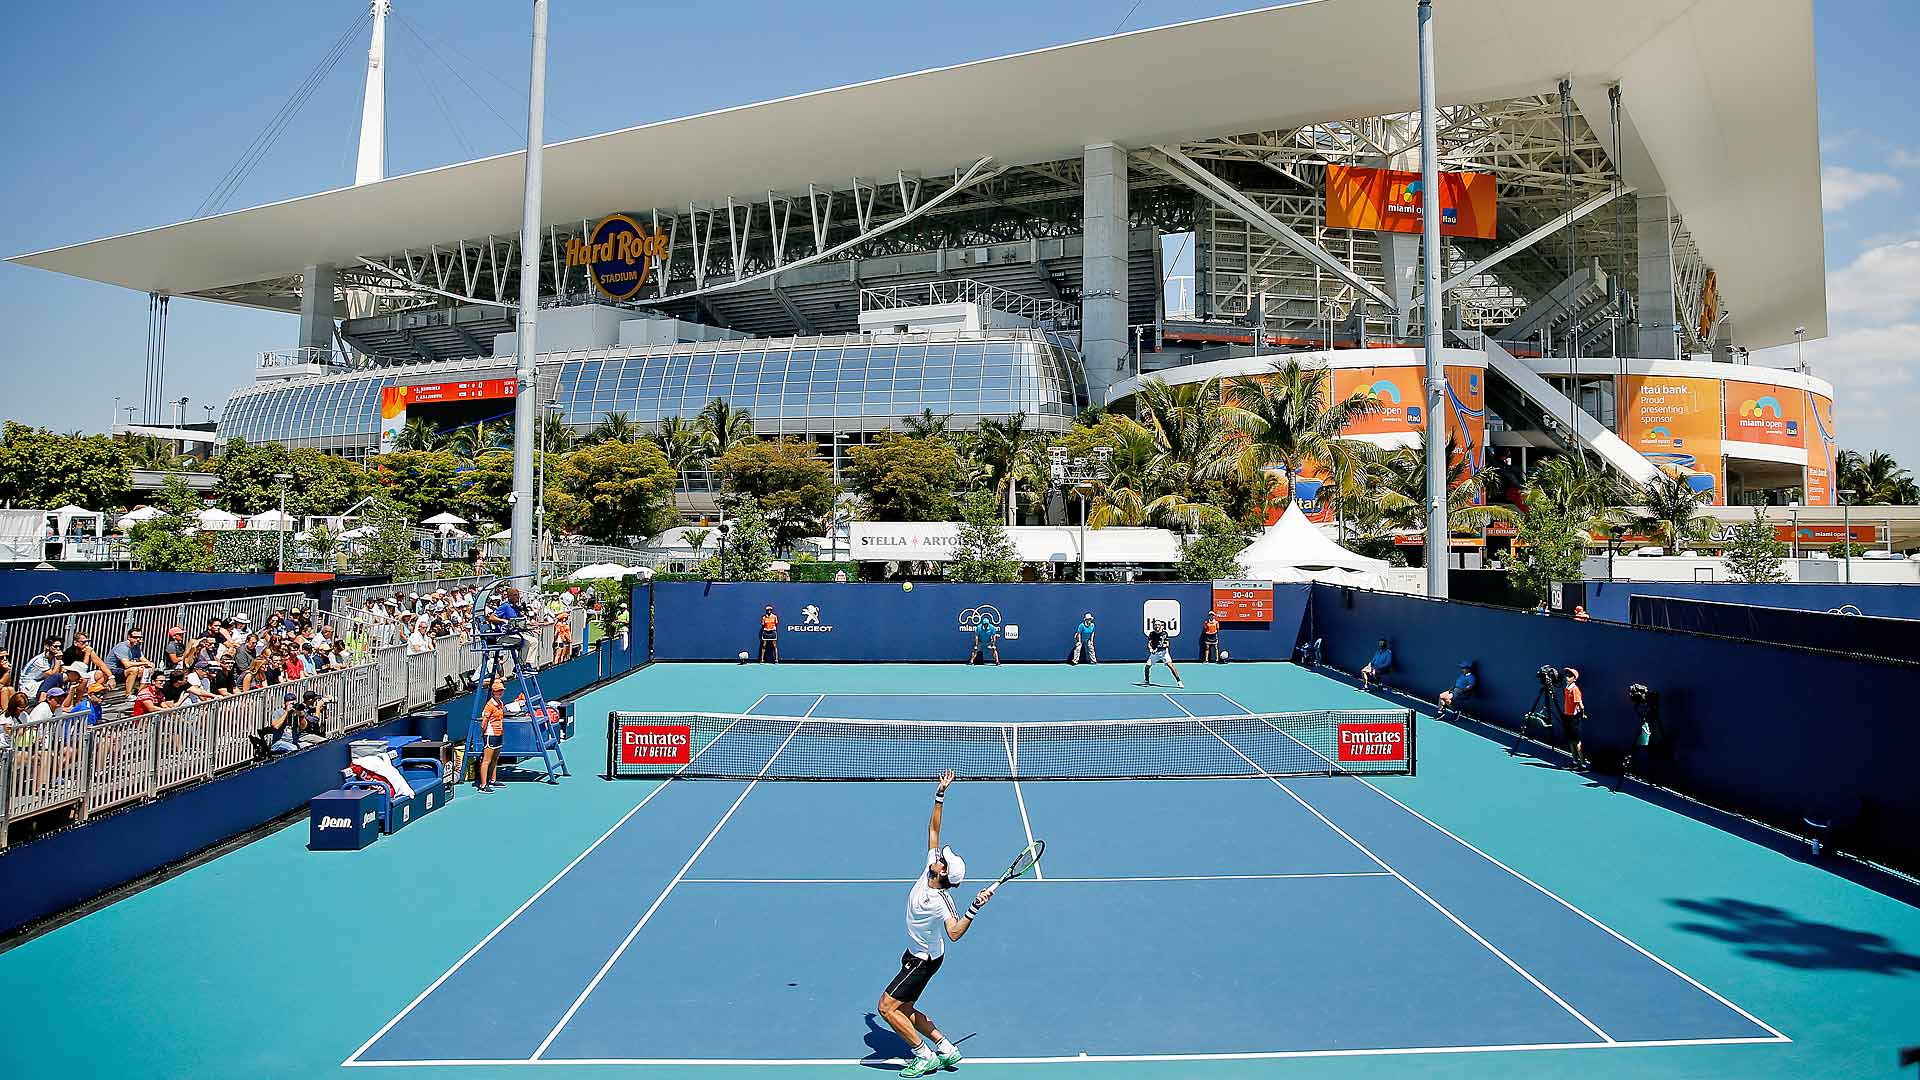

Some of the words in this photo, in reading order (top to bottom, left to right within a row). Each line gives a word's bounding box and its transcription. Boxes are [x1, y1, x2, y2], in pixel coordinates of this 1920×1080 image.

[1388, 204, 1414, 213] miami
[565, 232, 615, 268] Hard
[617, 227, 669, 265] Rock
[600, 271, 638, 284] STADIUM
[1641, 385, 1660, 394] Itaú
[1641, 396, 1665, 404] Proud
[1381, 407, 1402, 416] open
[1641, 405, 1684, 414] presenting
[1641, 416, 1672, 424] sponsor
[1740, 419, 1764, 427] miami
[1766, 421, 1782, 429] open
[861, 536, 907, 546] STELLA
[922, 536, 967, 546] ARTOI
[1232, 591, 1254, 599] 30-40
[1551, 590, 1562, 606] 09
[625, 731, 687, 745] Emirates
[1342, 730, 1401, 743] Emirates
[634, 746, 647, 757] FLY
[649, 746, 678, 757] BETTER
[1351, 744, 1363, 755] FLY
[1365, 744, 1392, 755] BETTER
